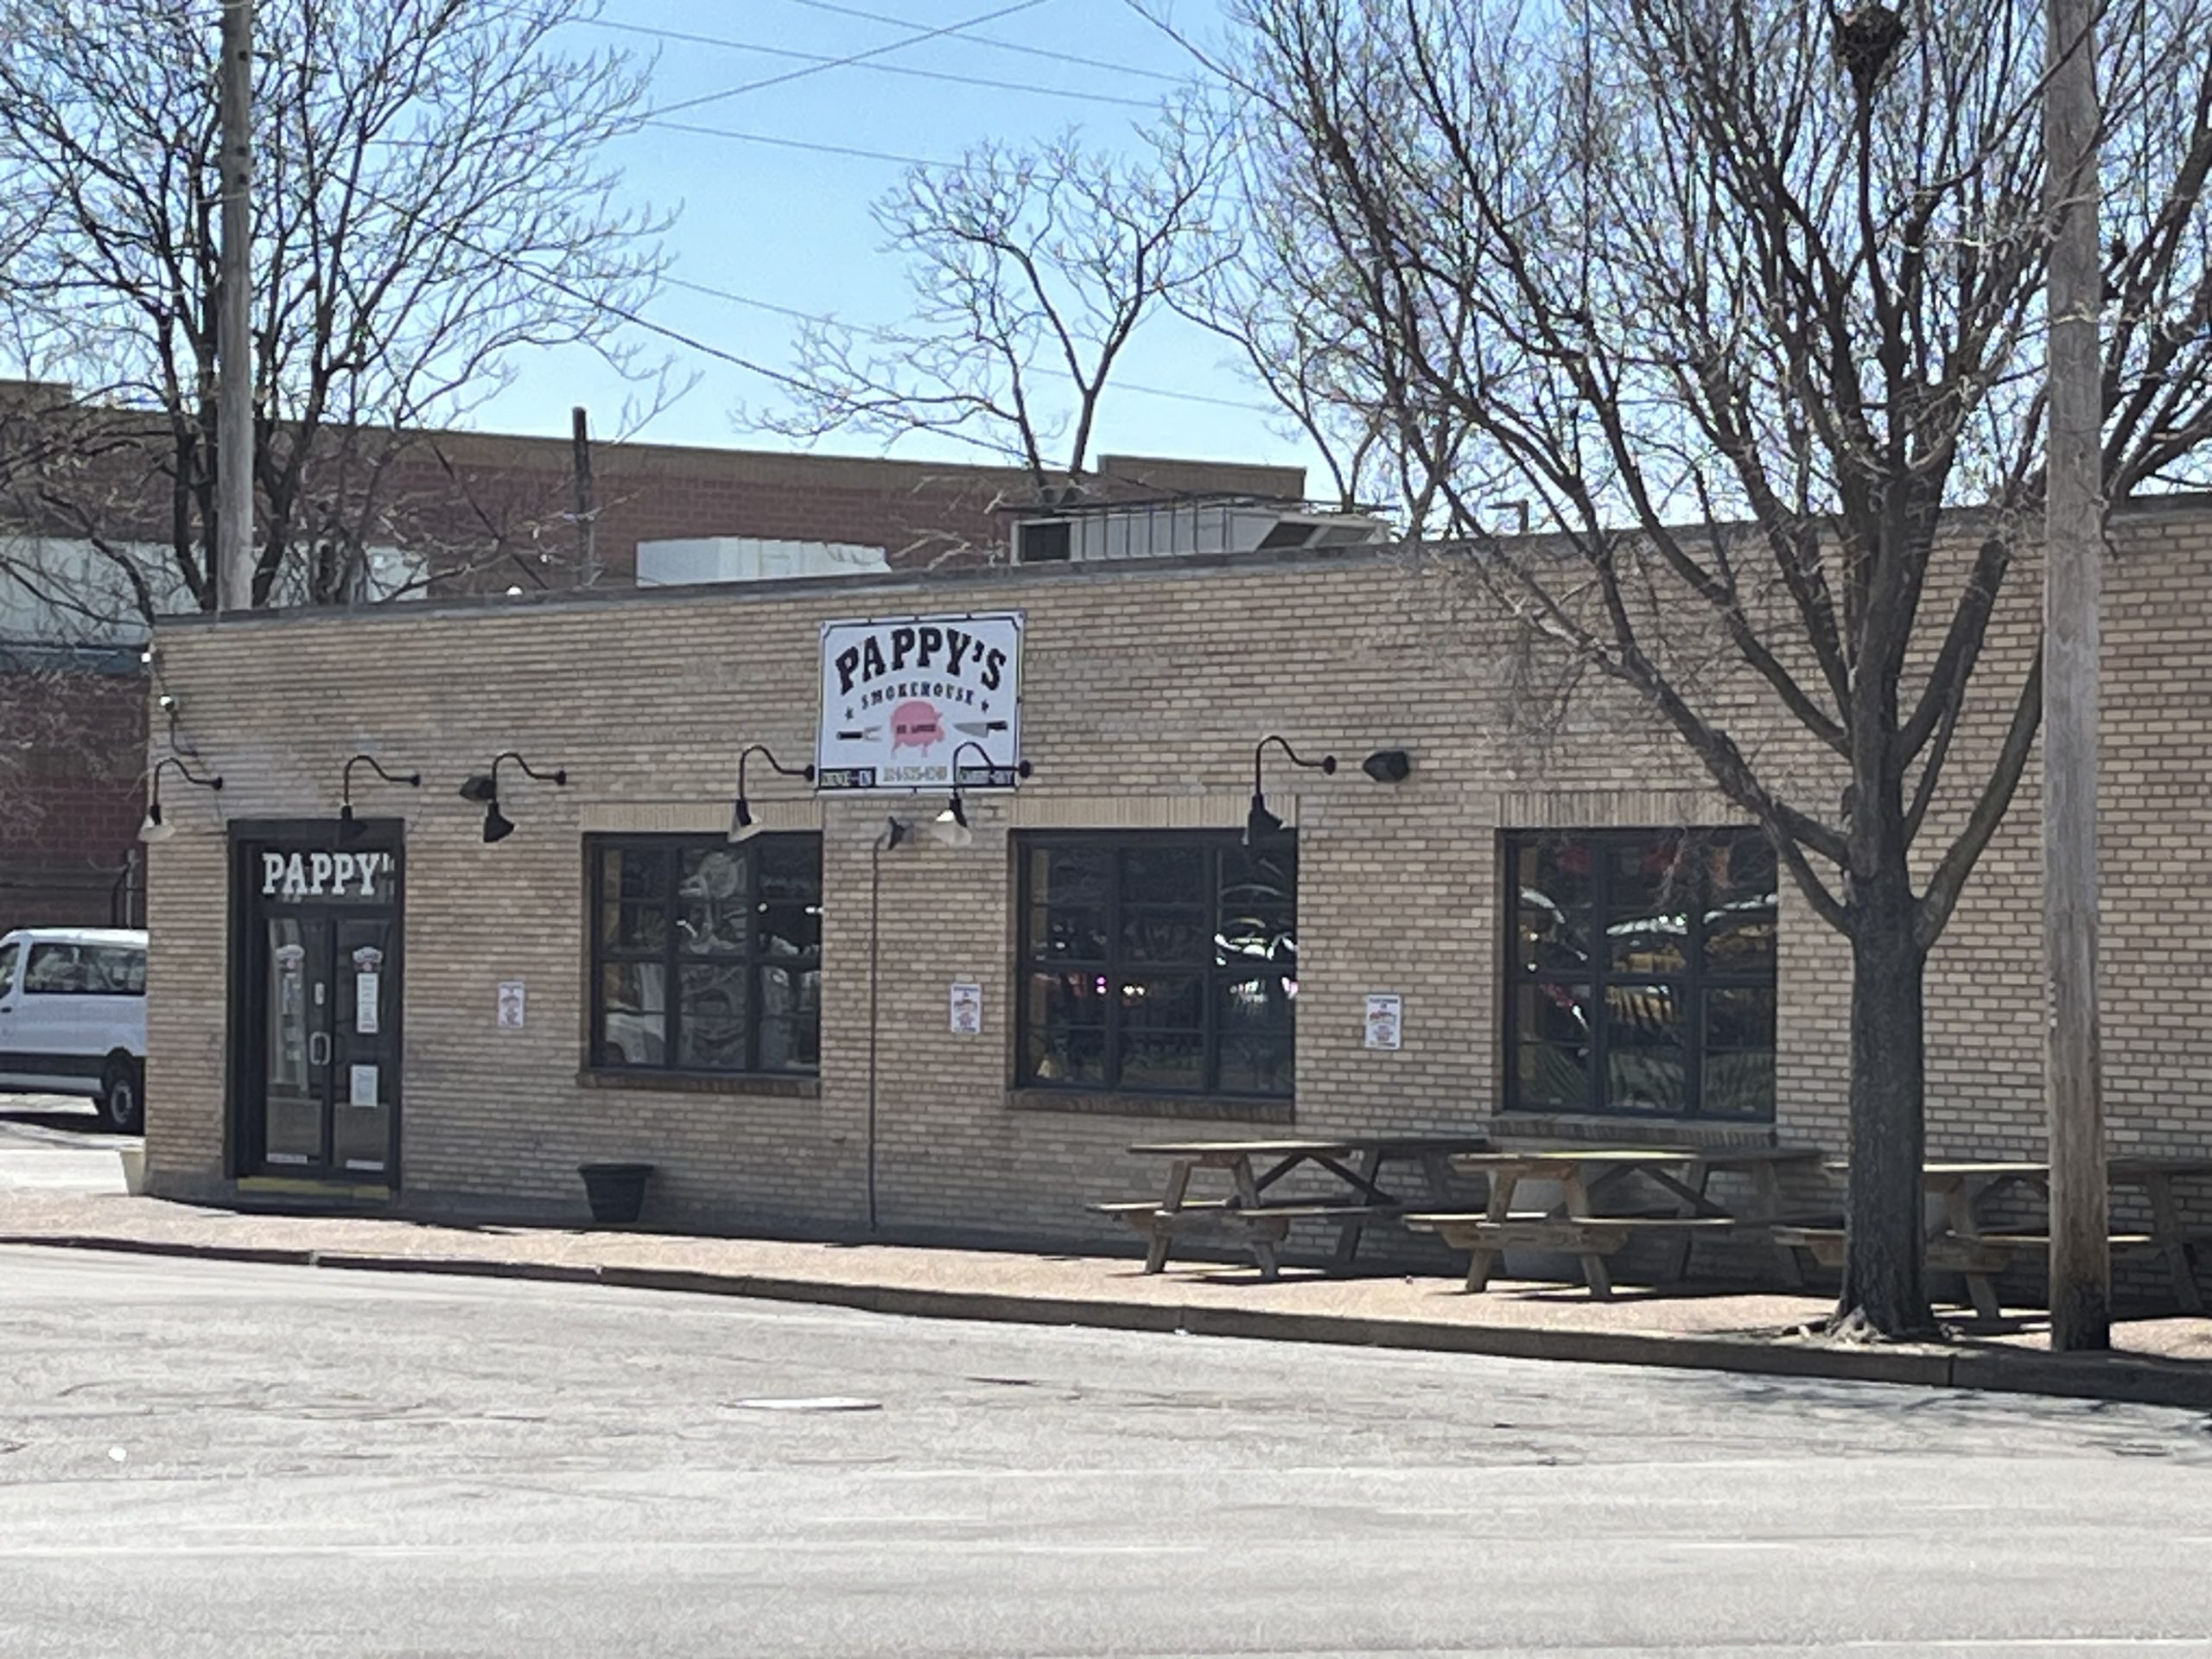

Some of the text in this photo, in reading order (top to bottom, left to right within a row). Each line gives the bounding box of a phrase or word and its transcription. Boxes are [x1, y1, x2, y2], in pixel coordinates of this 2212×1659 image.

[836, 627, 1007, 696] PAPPY'S
[861, 682, 974, 710] SMOKEHOUSE
[263, 853, 395, 895] PAPPY'
